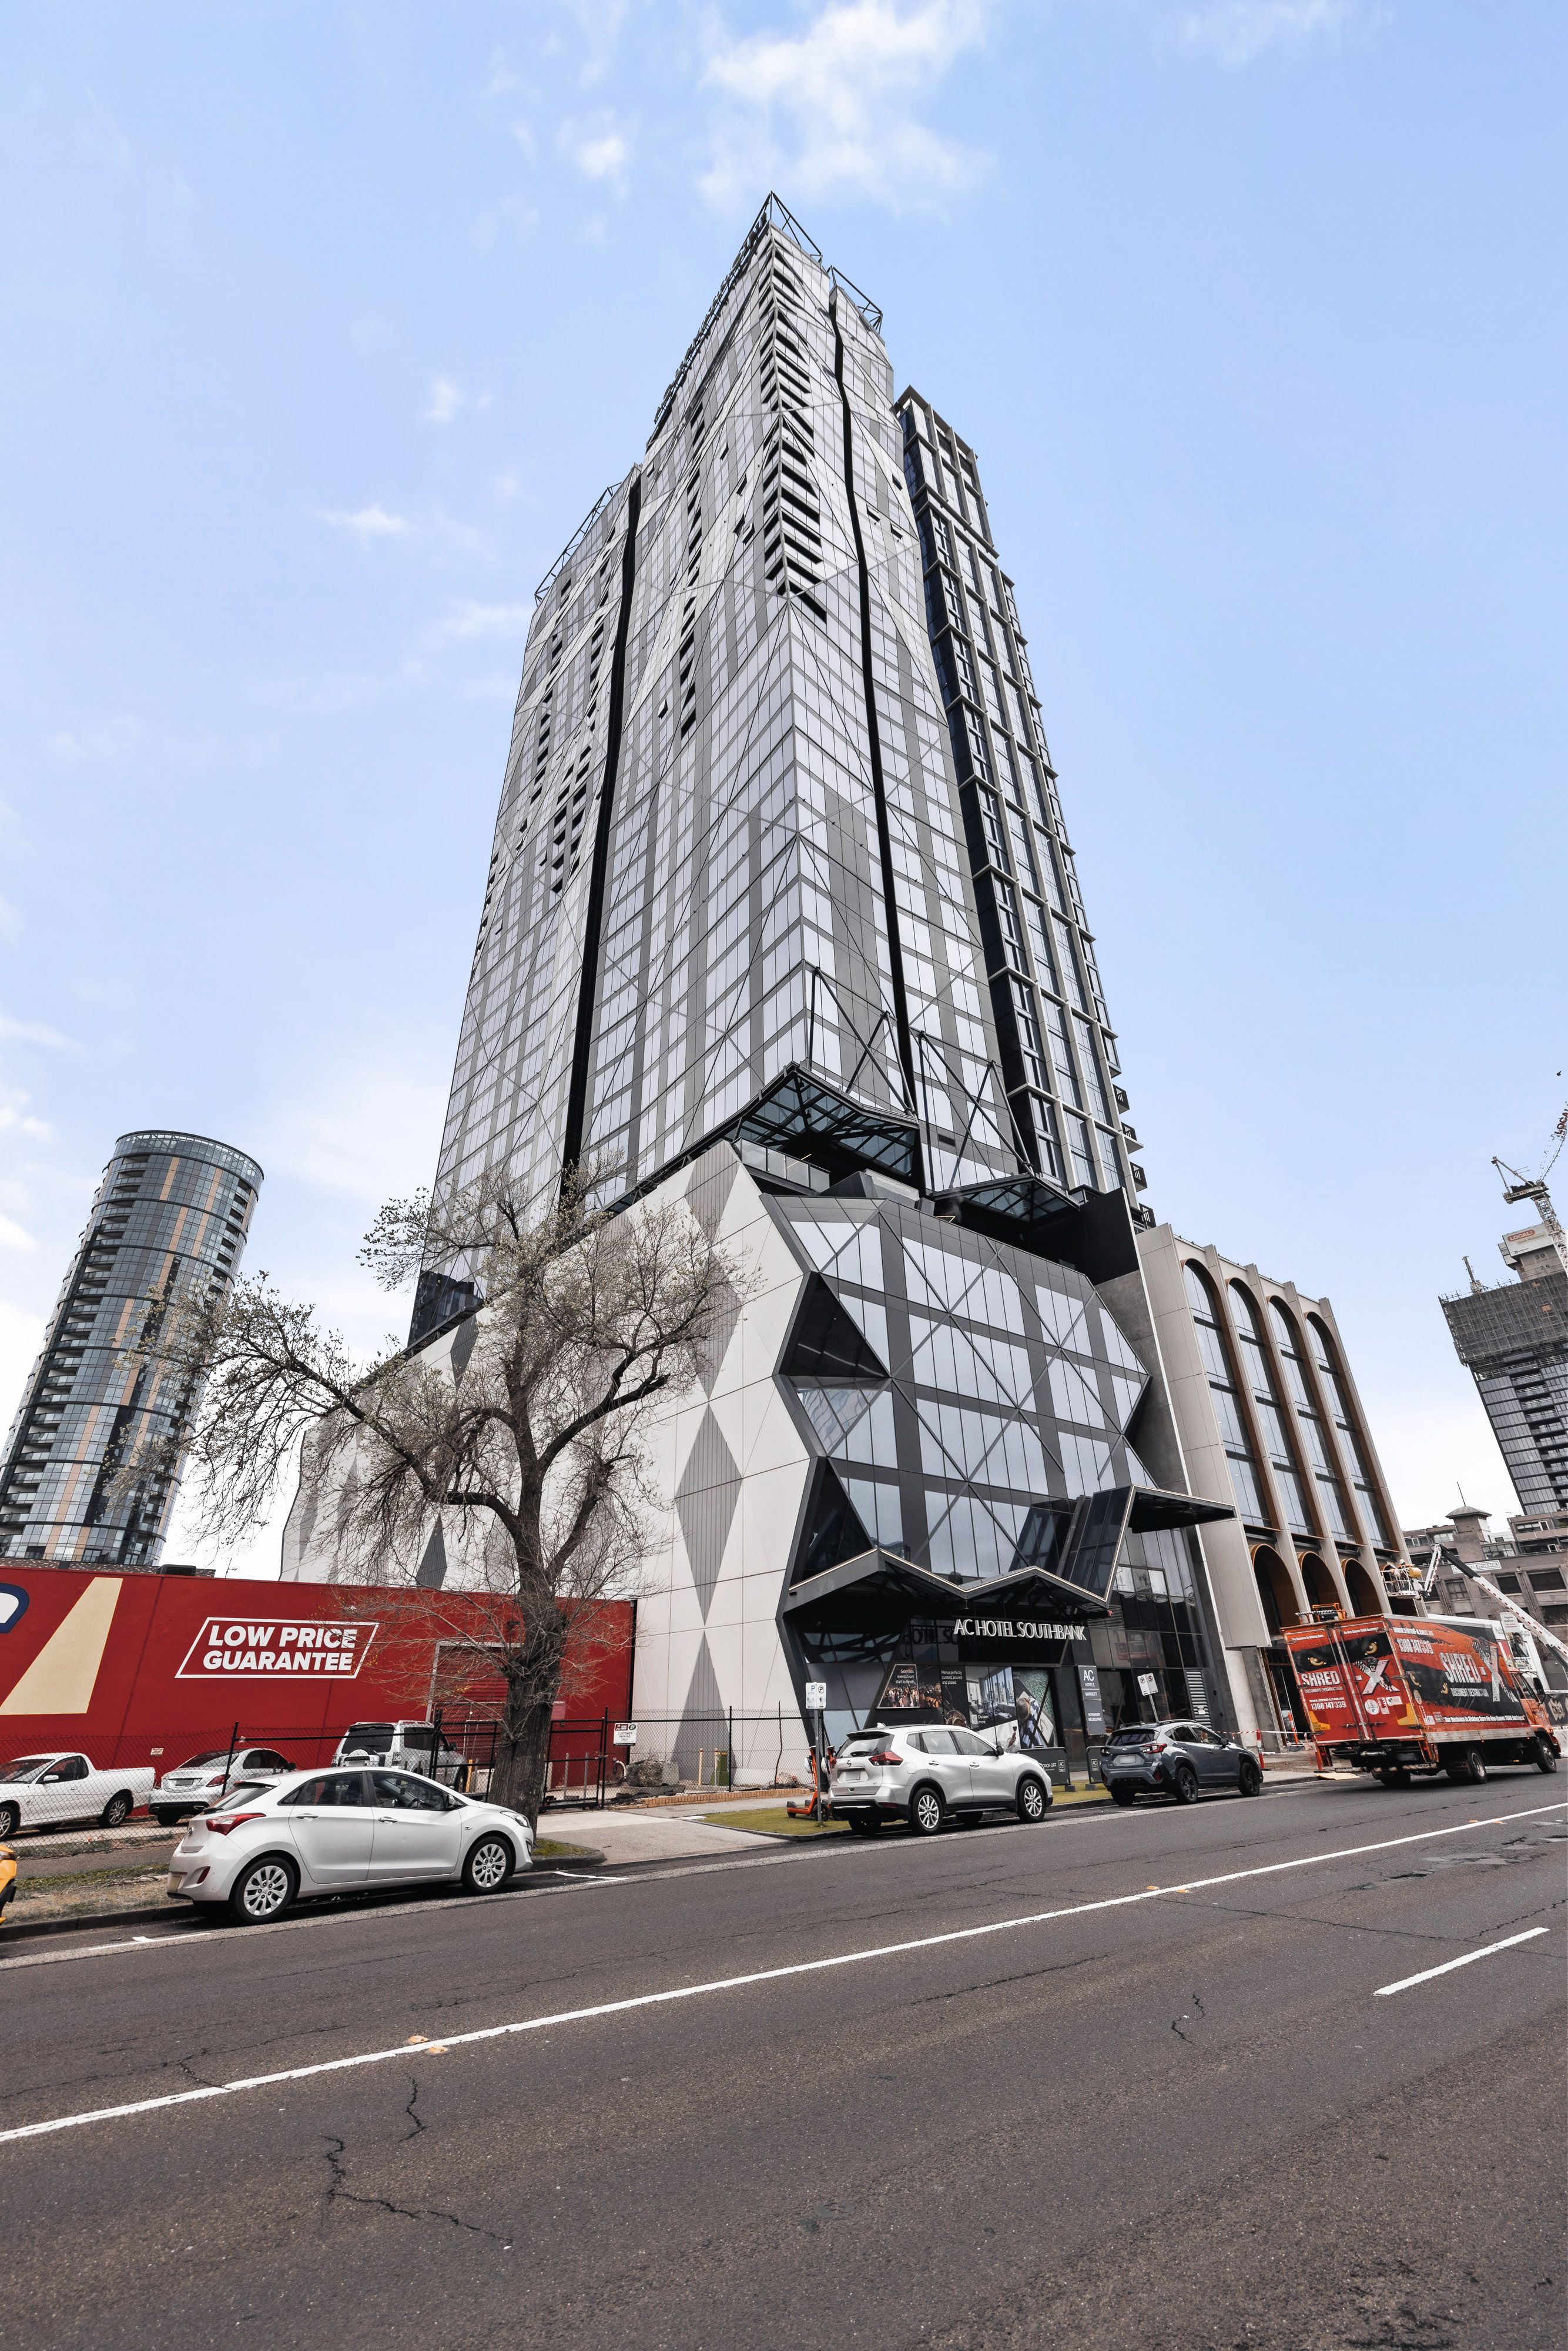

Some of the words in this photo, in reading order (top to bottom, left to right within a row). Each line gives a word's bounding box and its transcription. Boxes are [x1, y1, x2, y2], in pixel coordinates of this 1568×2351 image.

[208, 1625, 276, 1647] LOW
[279, 1627, 358, 1649] PRICE
[953, 1619, 974, 1636] AC
[975, 1620, 1017, 1638] HOTEL
[1017, 1622, 1087, 1640] SOUTHBANK
[1397, 1638, 1413, 1653] 1300
[1419, 1640, 1434, 1655] 339
[203, 1650, 354, 1671] GUARANTEE
[1084, 1670, 1094, 1681] AC
[1450, 1688, 1469, 1697] DOCUMENT
[1468, 1688, 1489, 1697] DESTRUCTION
[1311, 1702, 1325, 1710] 1300
[1334, 1700, 1346, 1709] 339
